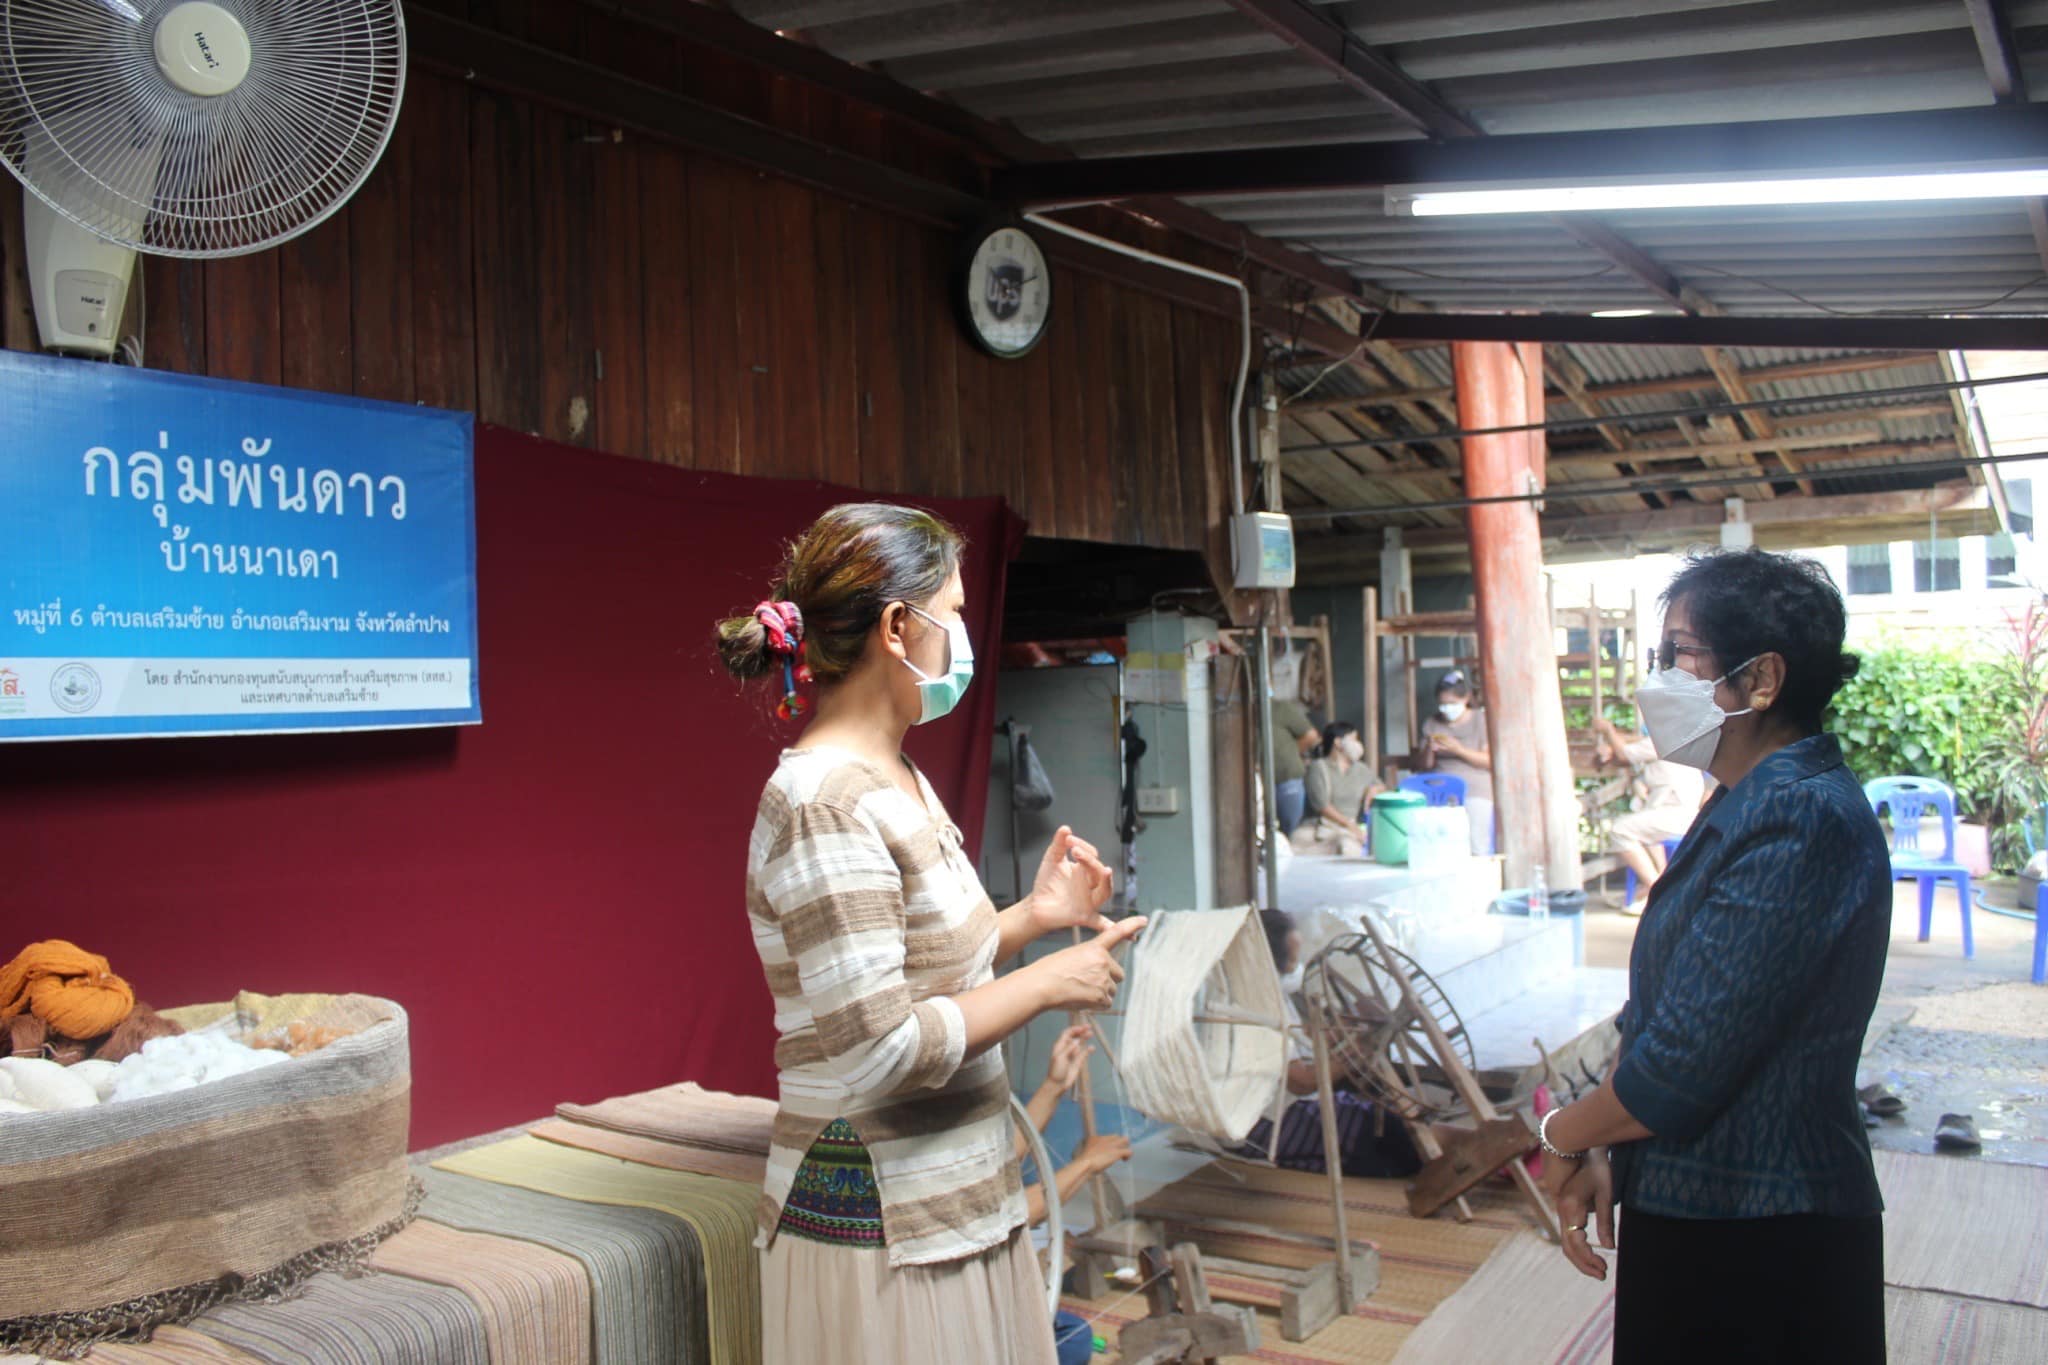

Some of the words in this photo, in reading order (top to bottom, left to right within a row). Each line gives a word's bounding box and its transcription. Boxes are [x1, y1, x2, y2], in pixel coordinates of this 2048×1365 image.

[194, 31, 219, 69] Hatari
[83, 430, 406, 528] กลุ่มพันดาว
[160, 524, 339, 579] บ้านนาเดา
[14, 597, 62, 634] หมู่ที่
[70, 608, 83, 626] 6
[231, 608, 349, 632] อำเภอเสริมงาม
[356, 610, 449, 633] จังหวัดลำปาง
[144, 669, 168, 685] โดย
[173, 669, 418, 690] สำนักงานกองทุนสนับสนุนการสร้างเสริมสุขภาพ
